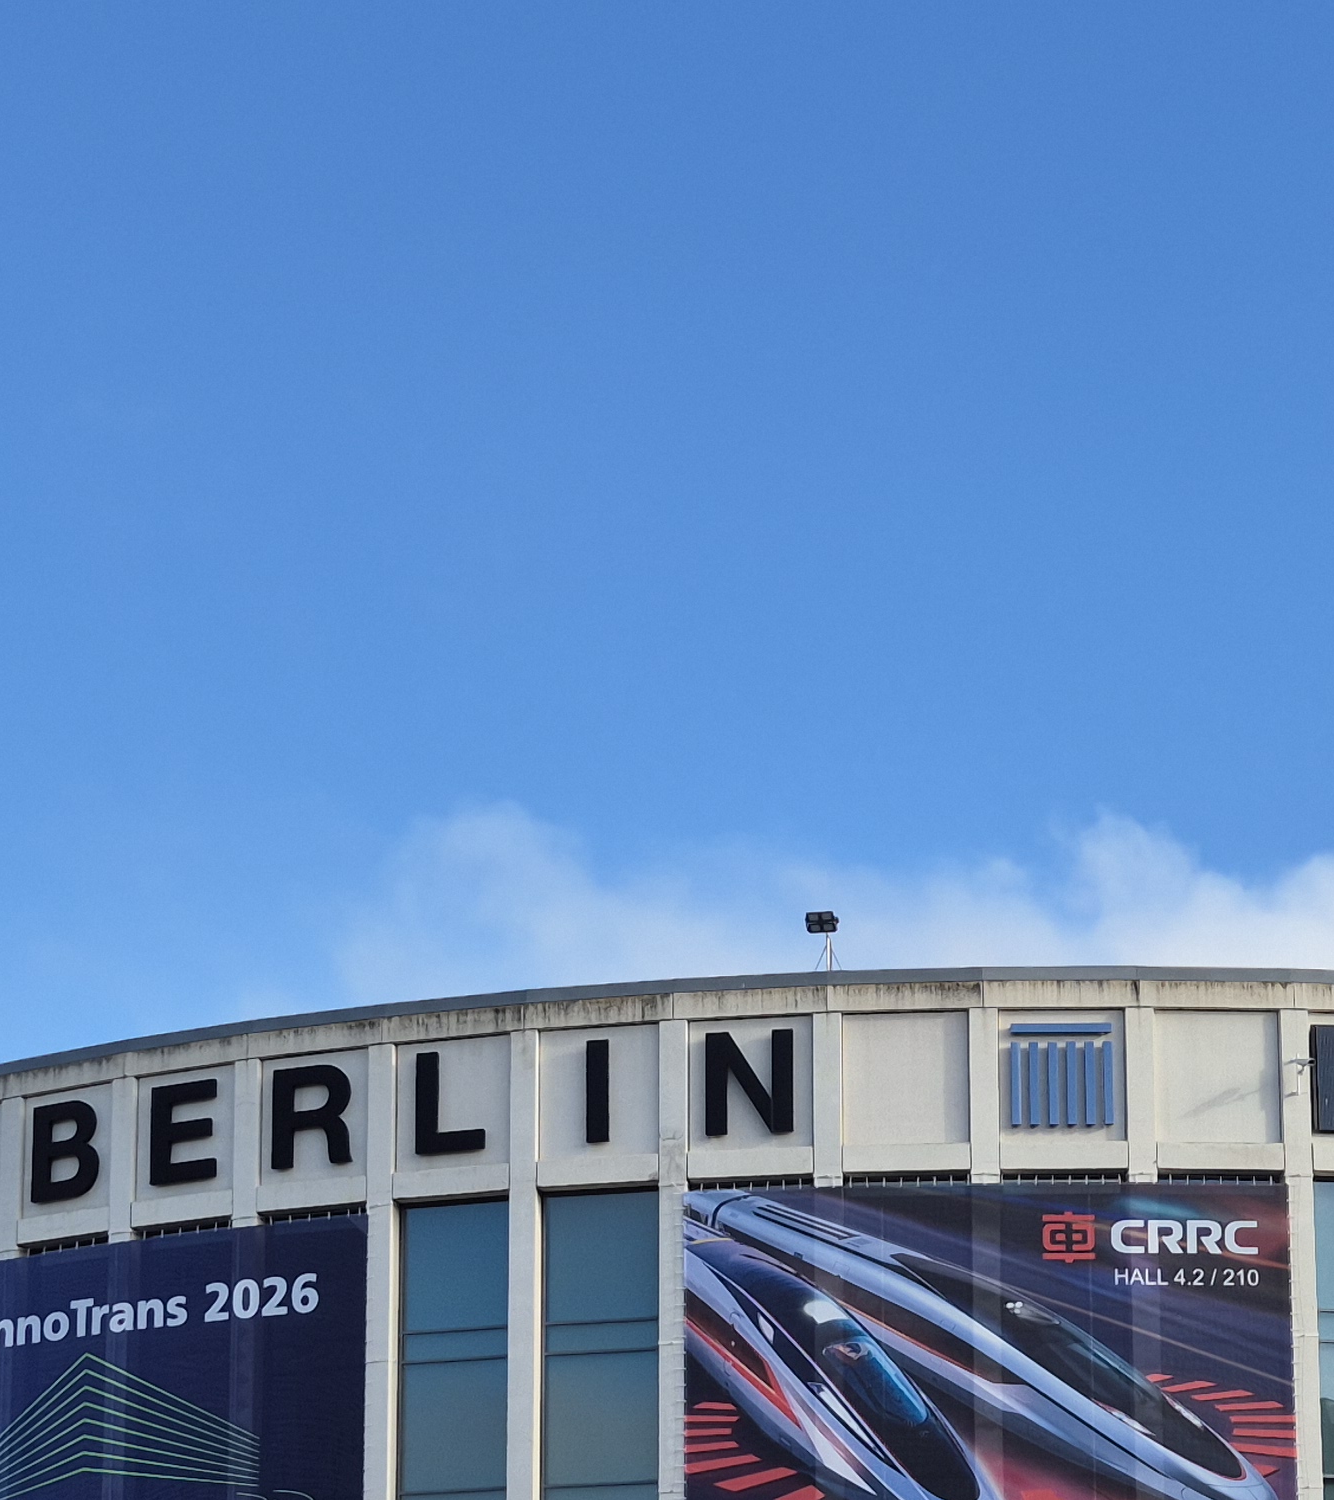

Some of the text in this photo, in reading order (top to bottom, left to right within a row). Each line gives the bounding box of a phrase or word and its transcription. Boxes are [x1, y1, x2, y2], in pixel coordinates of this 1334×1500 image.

[31, 1028, 794, 1204] BERLIN
[1110, 1219, 1259, 1254] CRRC
[204, 1273, 319, 1323] 2026
[1114, 1268, 1259, 1286] HALL 4.2 / 210
